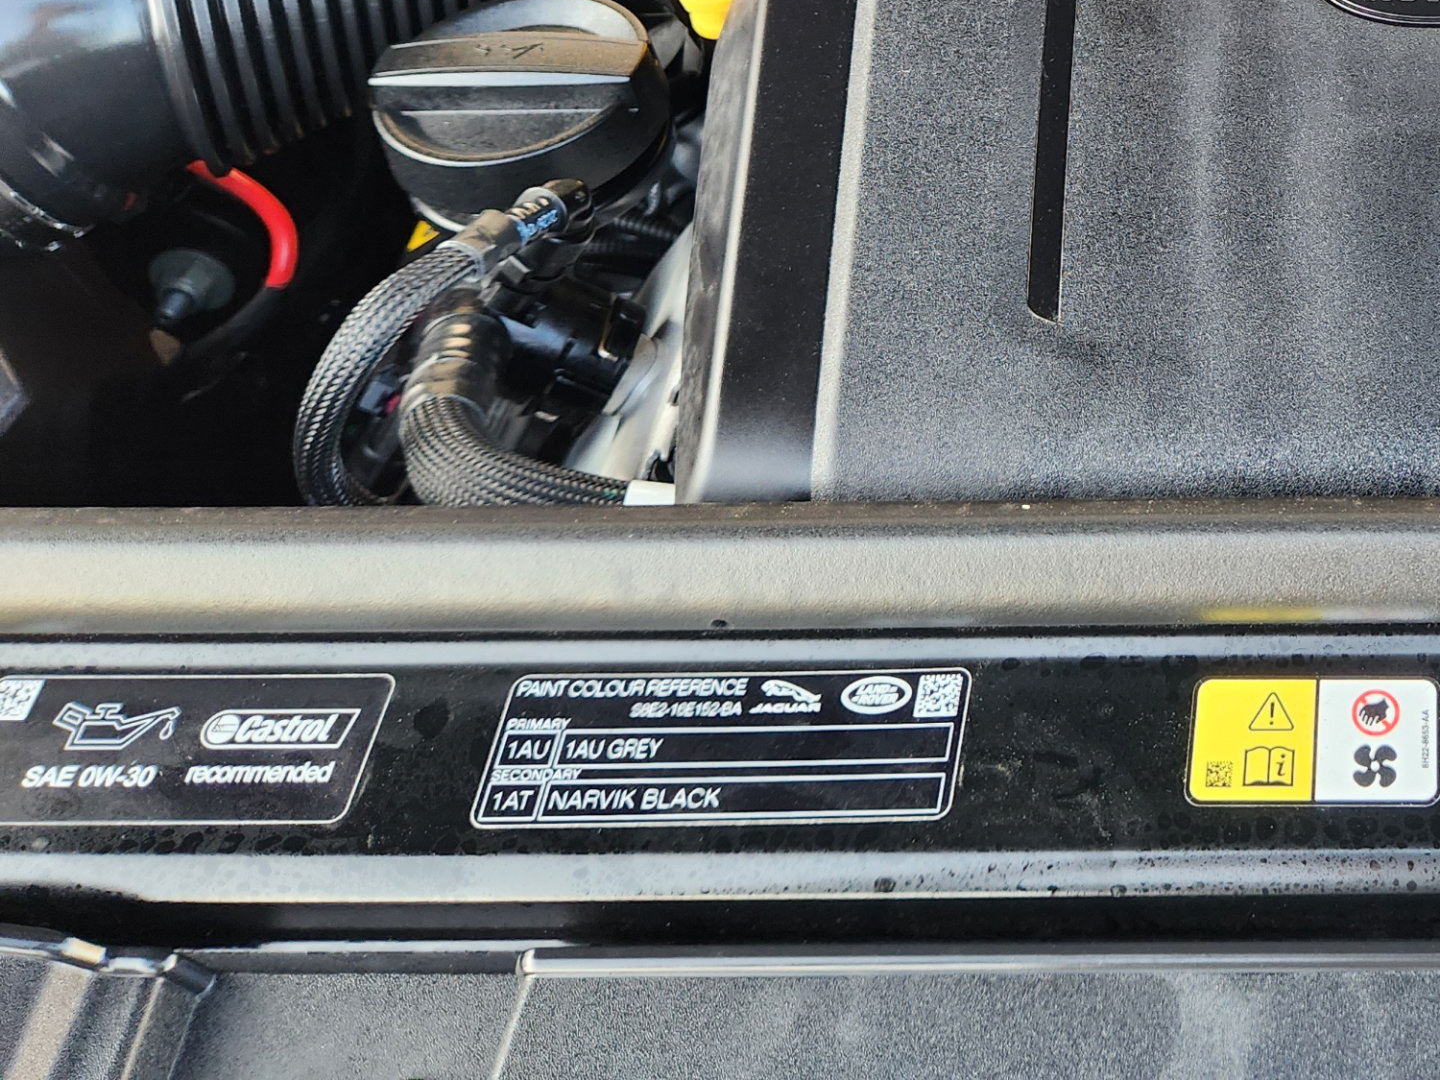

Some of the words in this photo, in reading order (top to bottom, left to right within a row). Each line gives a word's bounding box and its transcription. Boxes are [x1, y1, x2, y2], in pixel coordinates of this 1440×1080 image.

[515, 679, 570, 698] PAINT
[567, 678, 646, 698] COLOUR
[645, 677, 750, 697] REFERENCE
[749, 701, 822, 715] JAGUAR
[236, 713, 333, 744] Castrol
[505, 717, 572, 731] PRIMARY
[507, 740, 551, 761] 1AU
[566, 739, 603, 761] 1AU
[604, 737, 664, 761] GREY
[21, 764, 75, 788] SAE
[78, 764, 158, 788] 0W-30
[183, 759, 336, 784] recommended
[491, 767, 583, 782] SECONDARY
[492, 789, 535, 812] 1AT
[547, 787, 637, 812] NARVIK
[639, 786, 722, 810] BLACK
